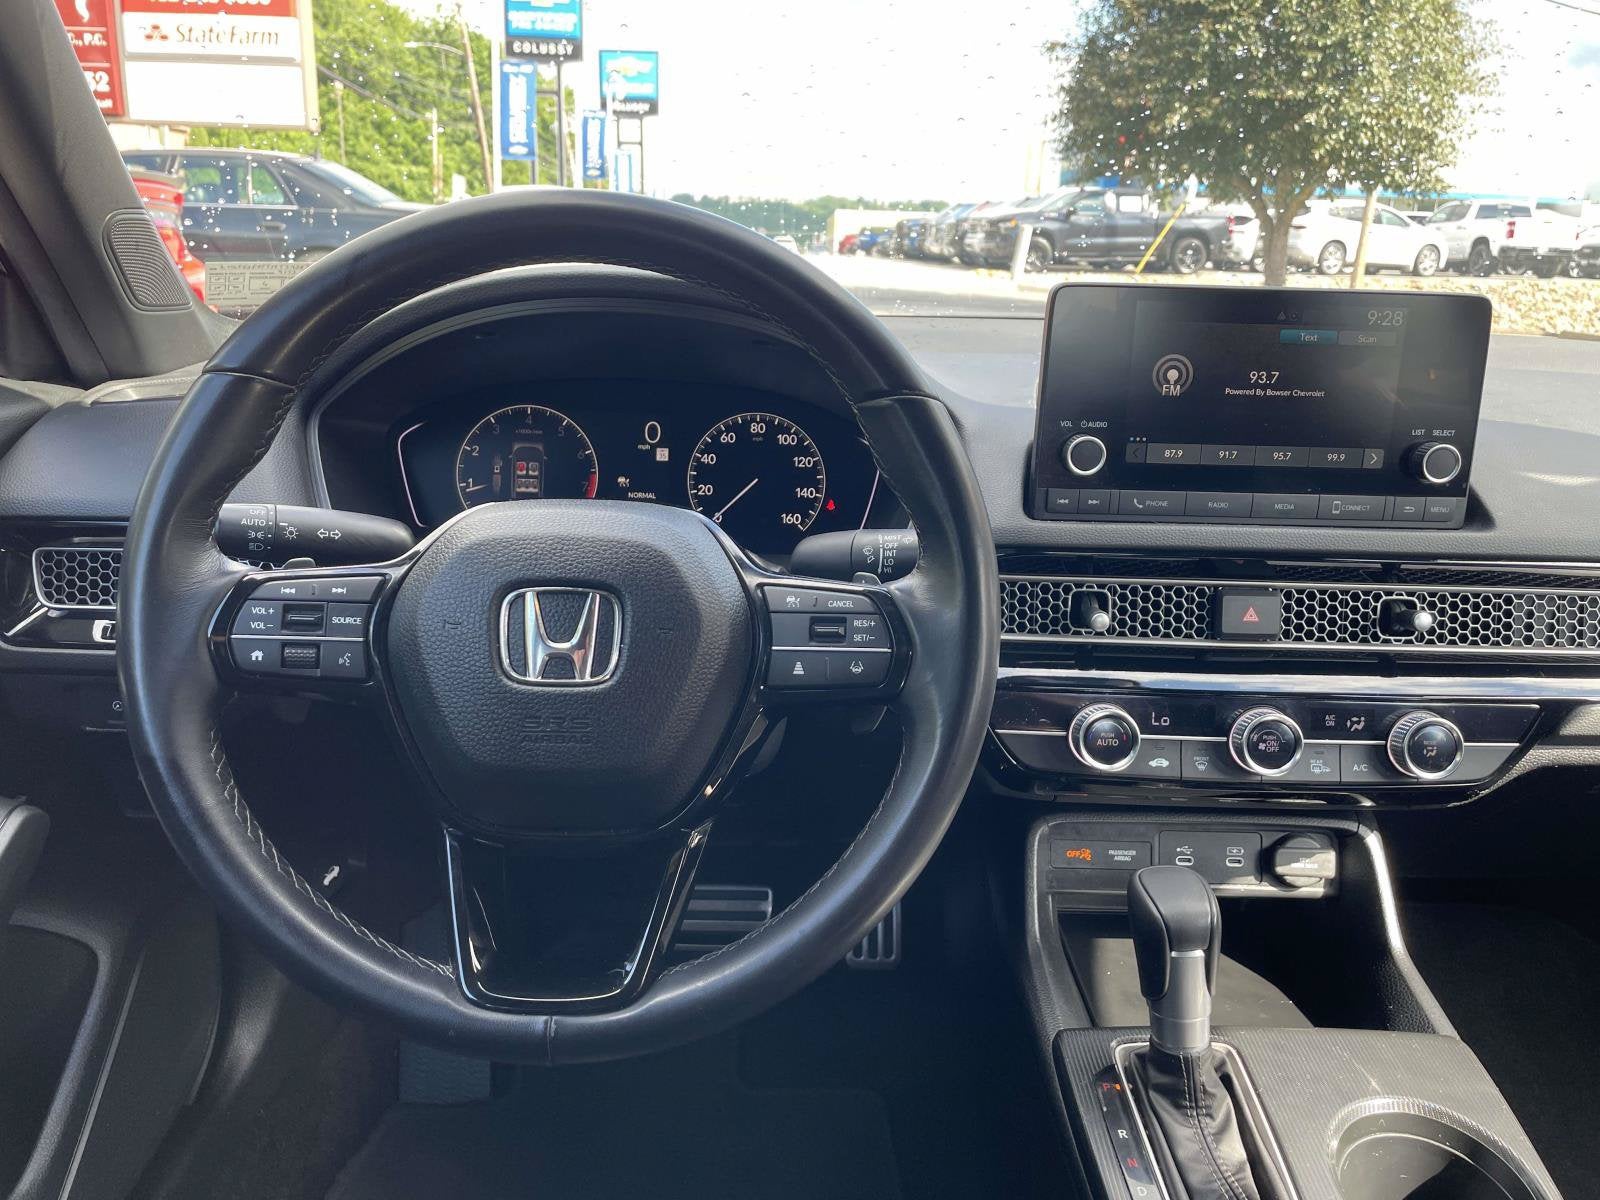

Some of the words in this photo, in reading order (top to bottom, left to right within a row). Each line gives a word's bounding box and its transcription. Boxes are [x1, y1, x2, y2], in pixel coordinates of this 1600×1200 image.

[1367, 310, 1403, 326] 9:28
[1300, 332, 1318, 342] Text
[1358, 334, 1377, 343] Scan
[1249, 371, 1279, 384] 93.7
[1162, 385, 1181, 397] FM
[1225, 387, 1253, 397] Powered
[1256, 388, 1265, 398] By
[1267, 388, 1291, 398] Bowser
[1292, 389, 1326, 398] Chevrolet
[645, 421, 661, 443] 0
[750, 422, 766, 434] 80
[720, 432, 736, 443] 60
[1432, 429, 1456, 437] SELECT
[777, 434, 798, 445] 100
[472, 445, 480, 456] 2
[1164, 449, 1184, 458] 87.9
[1218, 451, 1237, 459] 91.7
[700, 453, 717, 465] 40
[1273, 452, 1292, 460] 95.7
[1327, 453, 1346, 461] 99.9
[793, 456, 814, 468] 120
[697, 484, 714, 496] 20
[795, 487, 816, 499] 140
[628, 491, 656, 499] NORMAL
[1145, 500, 1169, 508] PHONE
[1208, 501, 1229, 509] RADIO
[1341, 504, 1371, 512] CONNECT
[248, 508, 267, 516] OFF
[1430, 505, 1450, 513] MENU
[240, 518, 267, 527] AUTO
[780, 513, 802, 525] 160
[884, 558, 894, 566] LO
[828, 600, 854, 608] CANCEL
[331, 616, 362, 625] SOURCE
[1096, 738, 1119, 746] AUTO
[1353, 764, 1368, 772] A/C
[1066, 850, 1081, 859] OFF
[1117, 1129, 1128, 1139] R
[1126, 1158, 1139, 1168] N
[1137, 1186, 1148, 1197] D
